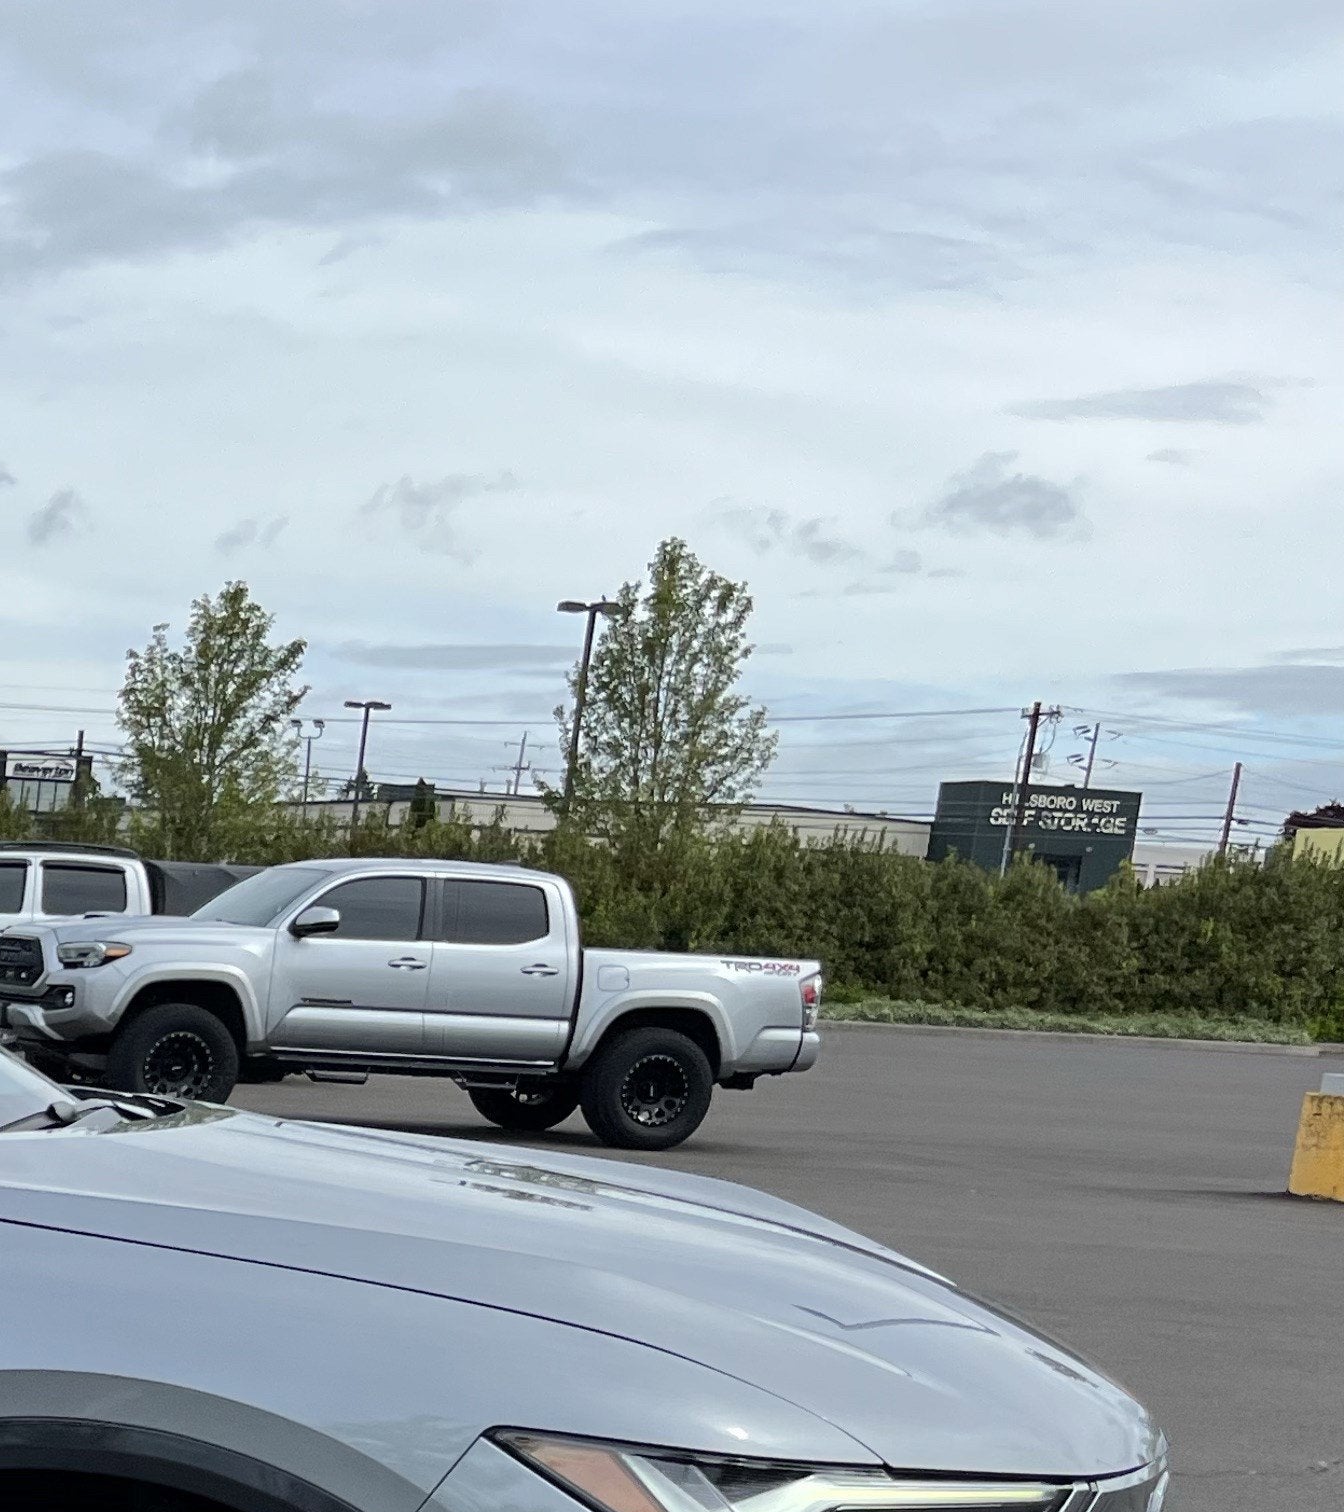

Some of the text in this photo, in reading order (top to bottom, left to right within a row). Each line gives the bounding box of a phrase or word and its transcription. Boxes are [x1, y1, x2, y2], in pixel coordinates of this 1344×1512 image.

[1001, 792, 1121, 813] HISBORO WEST
[989, 807, 1036, 826] SEF
[720, 960, 763, 973] TRD
